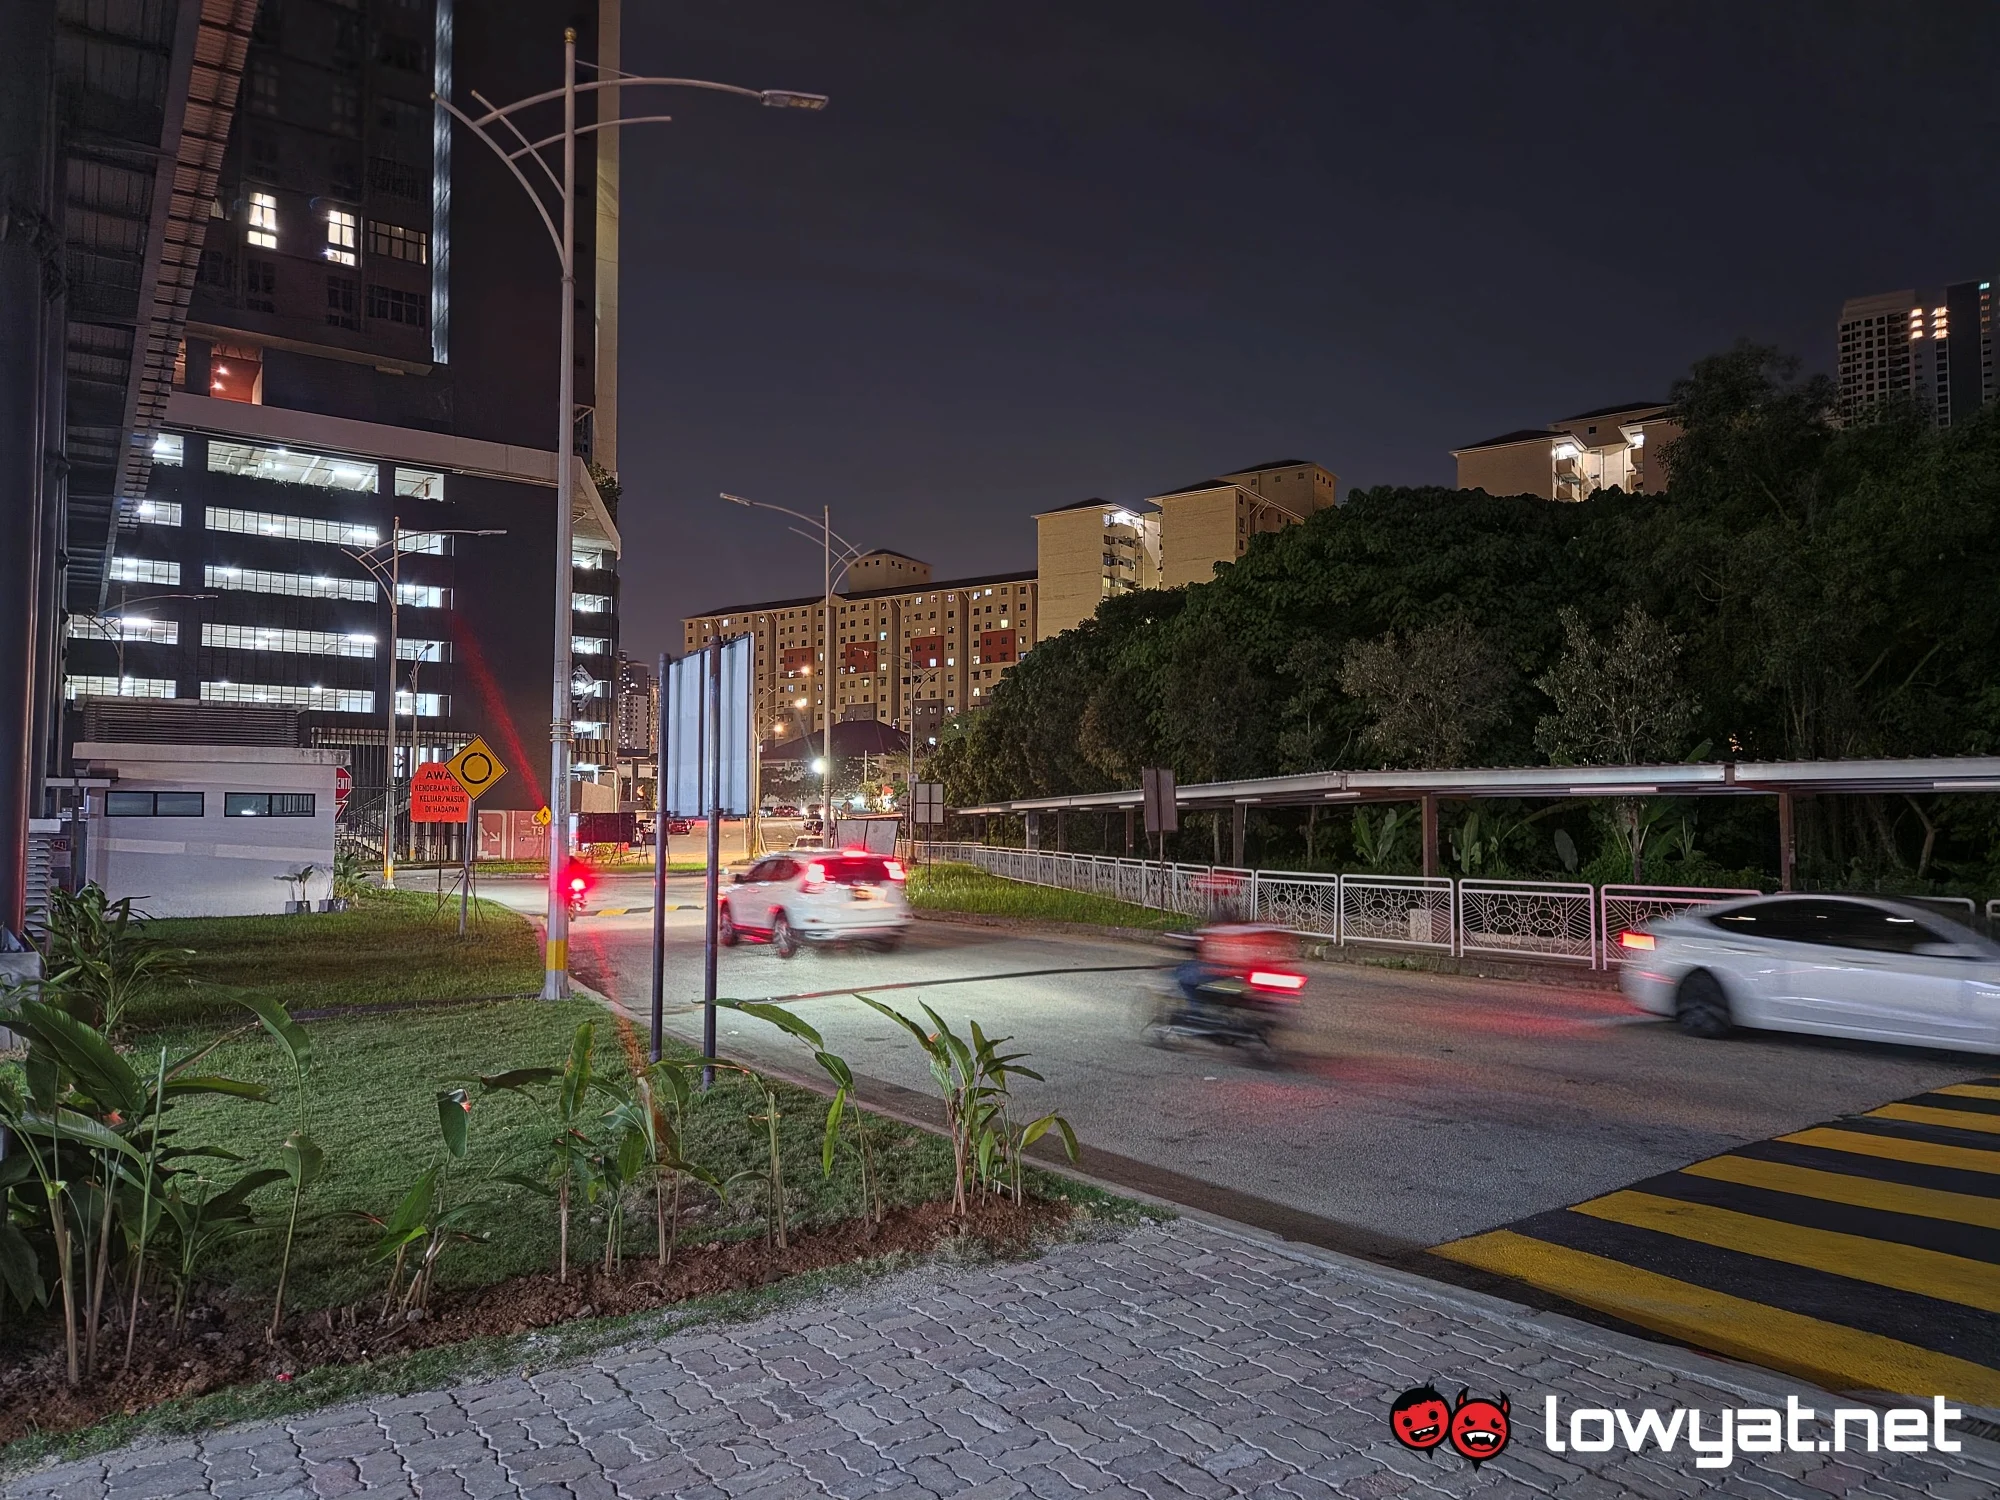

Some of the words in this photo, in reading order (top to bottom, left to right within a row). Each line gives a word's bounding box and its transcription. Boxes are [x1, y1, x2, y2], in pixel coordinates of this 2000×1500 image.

[425, 771, 452, 780] AWA
[336, 778, 351, 790] ENTI
[415, 784, 449, 792] KENDERAAN
[451, 785, 464, 793] BER
[419, 795, 465, 803] KELUAR/MASUK
